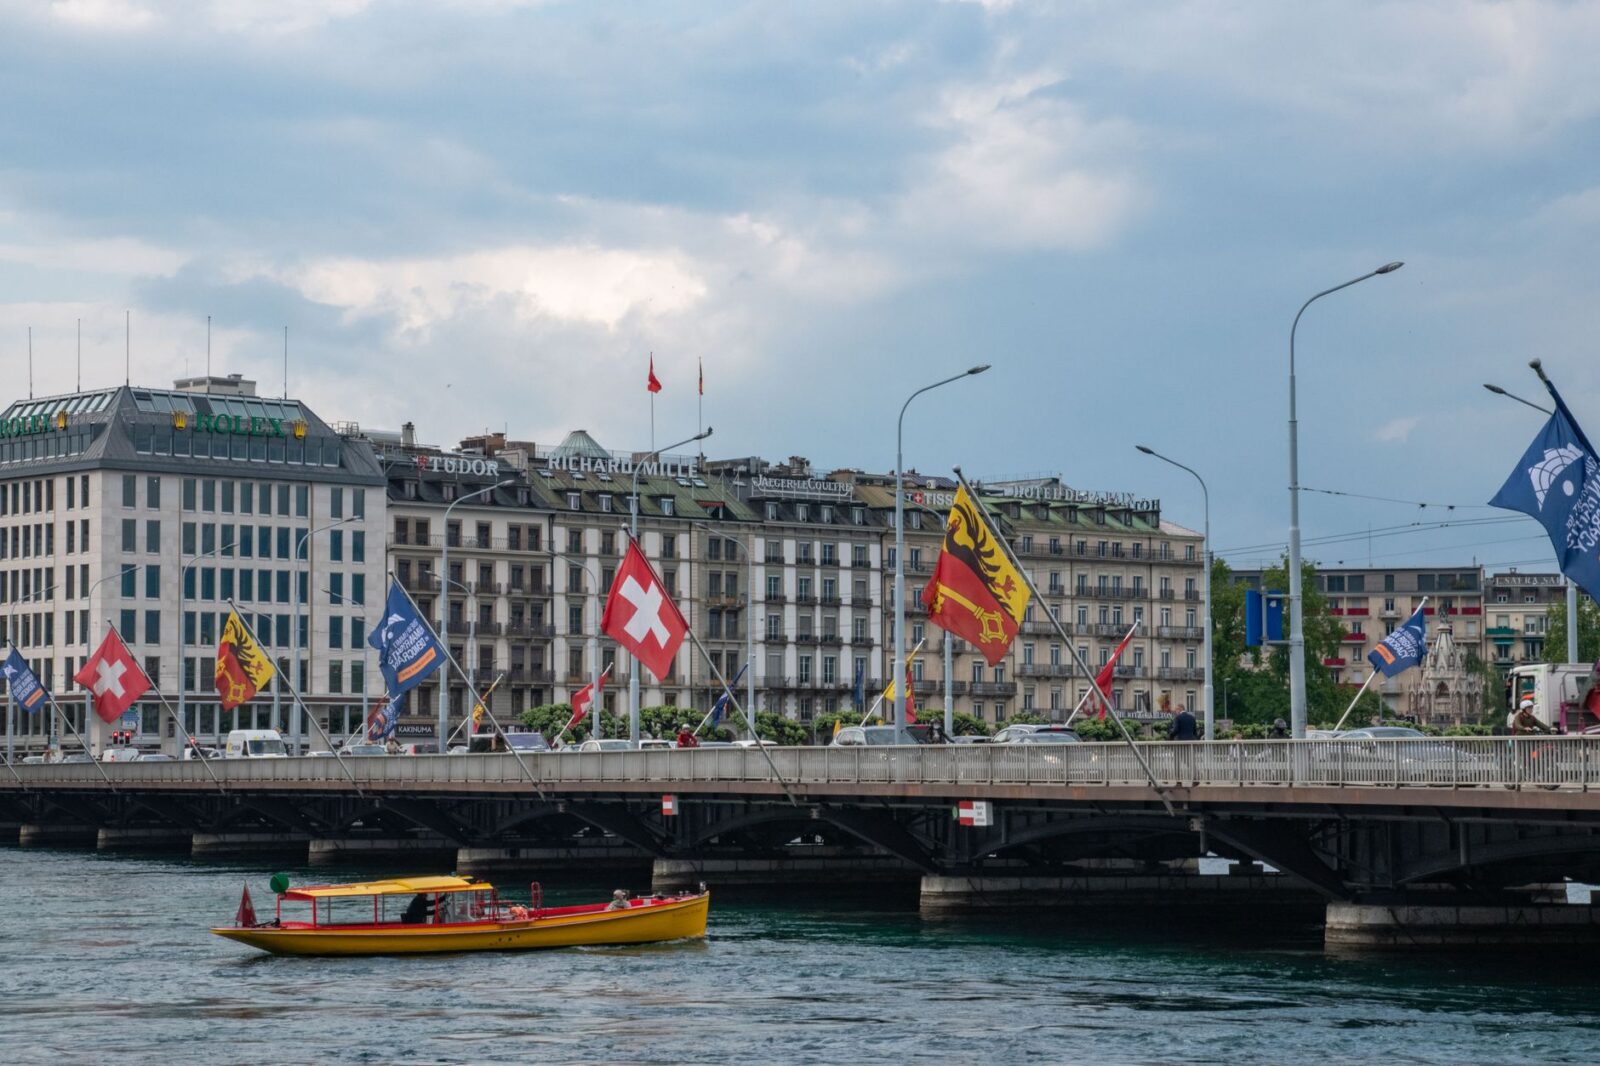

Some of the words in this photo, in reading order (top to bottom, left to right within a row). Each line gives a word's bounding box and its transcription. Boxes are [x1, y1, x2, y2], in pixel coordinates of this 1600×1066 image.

[0, 414, 54, 438] ROLEX
[195, 412, 285, 438] ROLEX
[429, 456, 499, 476] TUDOR
[548, 455, 632, 474] RICHARD
[643, 461, 698, 478] MILLE
[924, 493, 953, 507] TISS
[398, 725, 432, 734] KAKINUMA
